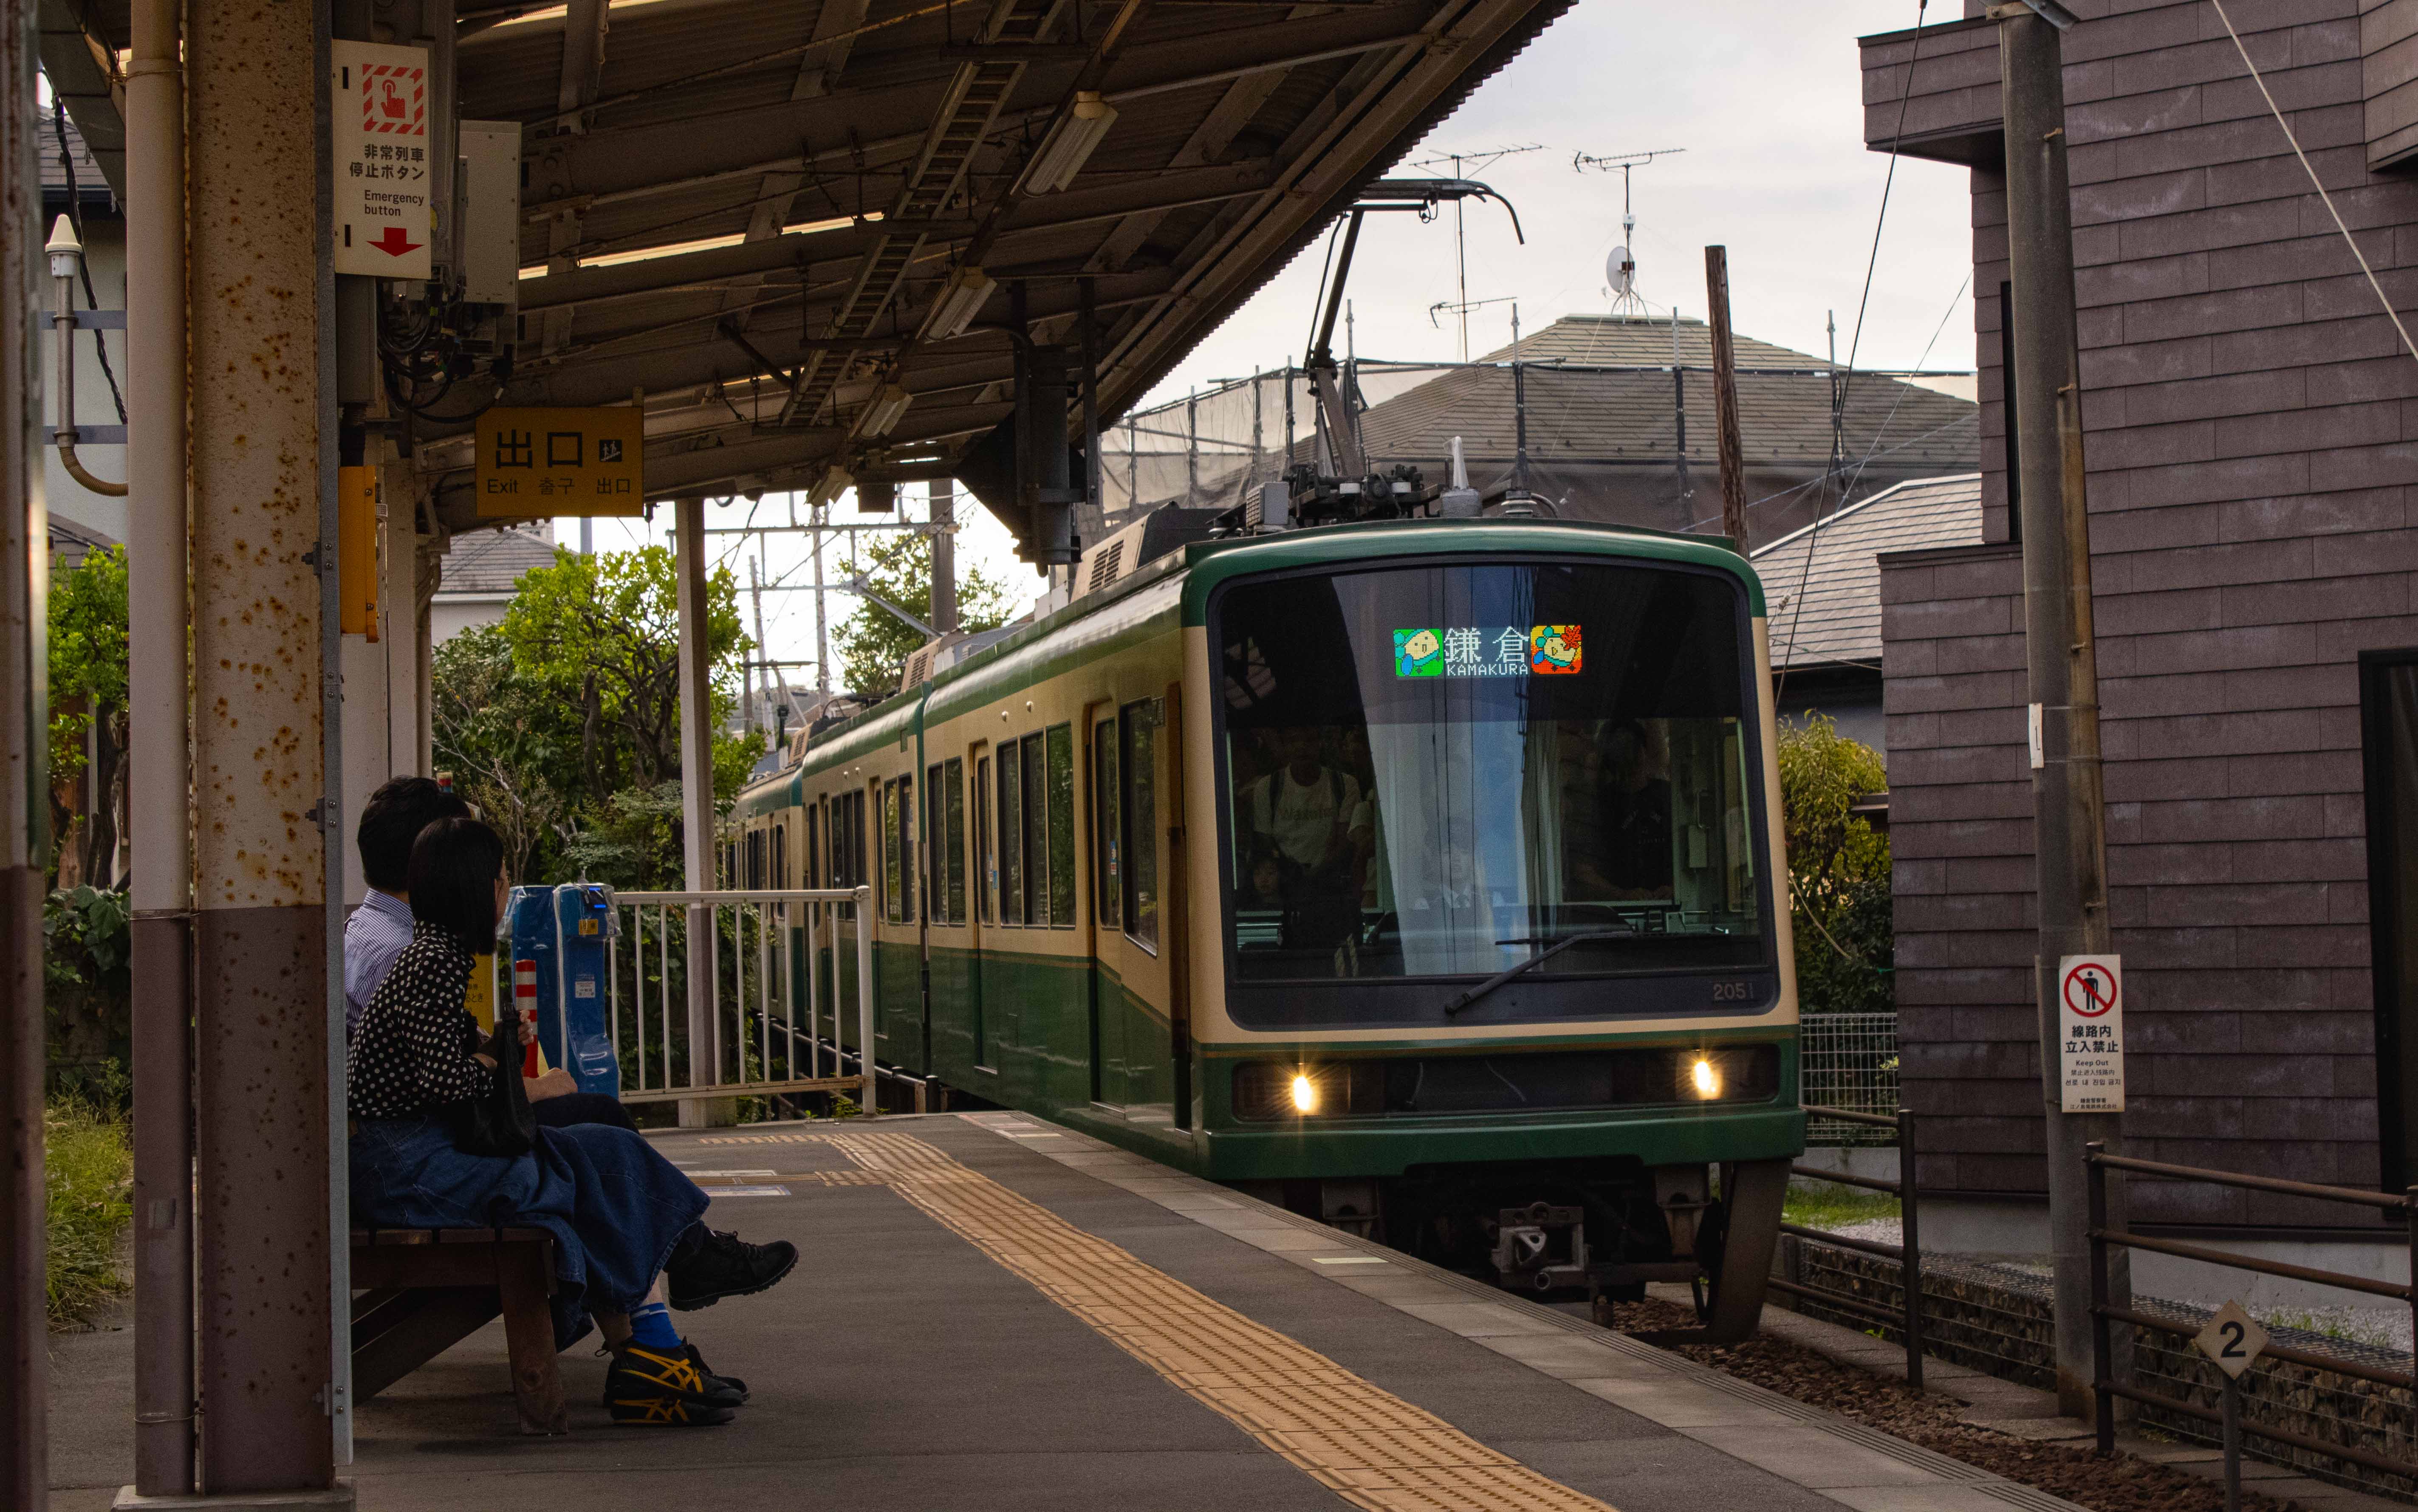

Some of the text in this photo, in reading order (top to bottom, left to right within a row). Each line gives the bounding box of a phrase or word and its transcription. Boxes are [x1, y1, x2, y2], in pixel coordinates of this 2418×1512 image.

[364, 144, 424, 162] 非常列車
[349, 162, 424, 181] 停止ボタン
[364, 189, 424, 205] Emergency
[364, 204, 401, 216] button
[495, 429, 583, 469] 出口
[487, 479, 518, 494] Exit
[539, 477, 575, 496] 출구
[596, 477, 631, 495] 出口
[1443, 626, 1529, 663] 鎌倉
[1447, 663, 1528, 676] KAMAKURA
[2072, 1025, 2112, 1038] 線路内
[2065, 1040, 2119, 1053] 立入禁止
[2220, 1321, 2246, 1358] 2
